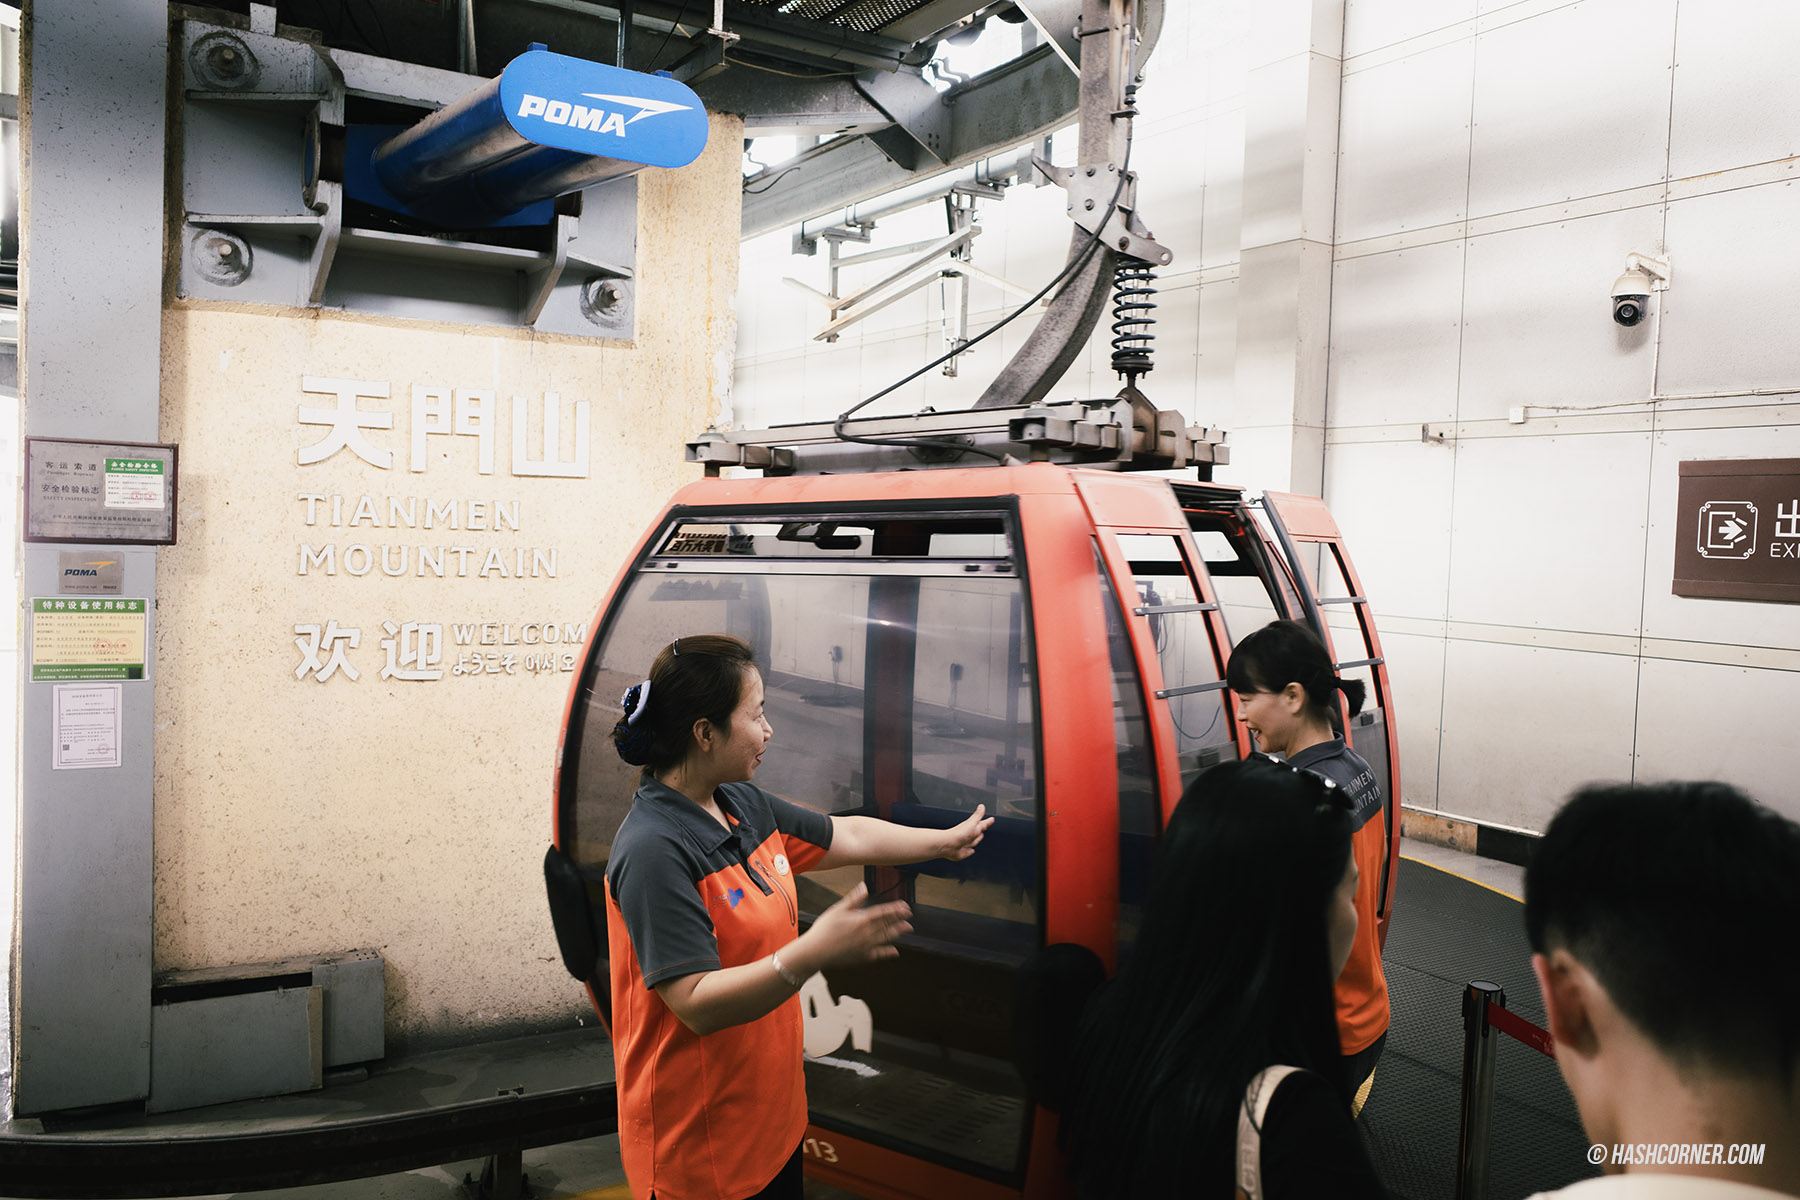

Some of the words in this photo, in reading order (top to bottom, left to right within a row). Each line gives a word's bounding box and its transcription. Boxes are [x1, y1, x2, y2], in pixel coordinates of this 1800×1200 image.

[517, 94, 627, 138] POMA
[297, 375, 591, 478] 天門山
[45, 461, 98, 471] 客运索道
[41, 484, 100, 495] 安全检验标志
[297, 493, 521, 531] TIANMEN
[1775, 500, 1800, 538] 出
[64, 568, 97, 576] POMA
[297, 543, 558, 578] MOUNTAIN
[42, 600, 138, 610] 特种设备使用标志
[294, 619, 443, 683] 欢迎
[452, 652, 518, 676] ようこそ
[525, 652, 557, 673] 어서
